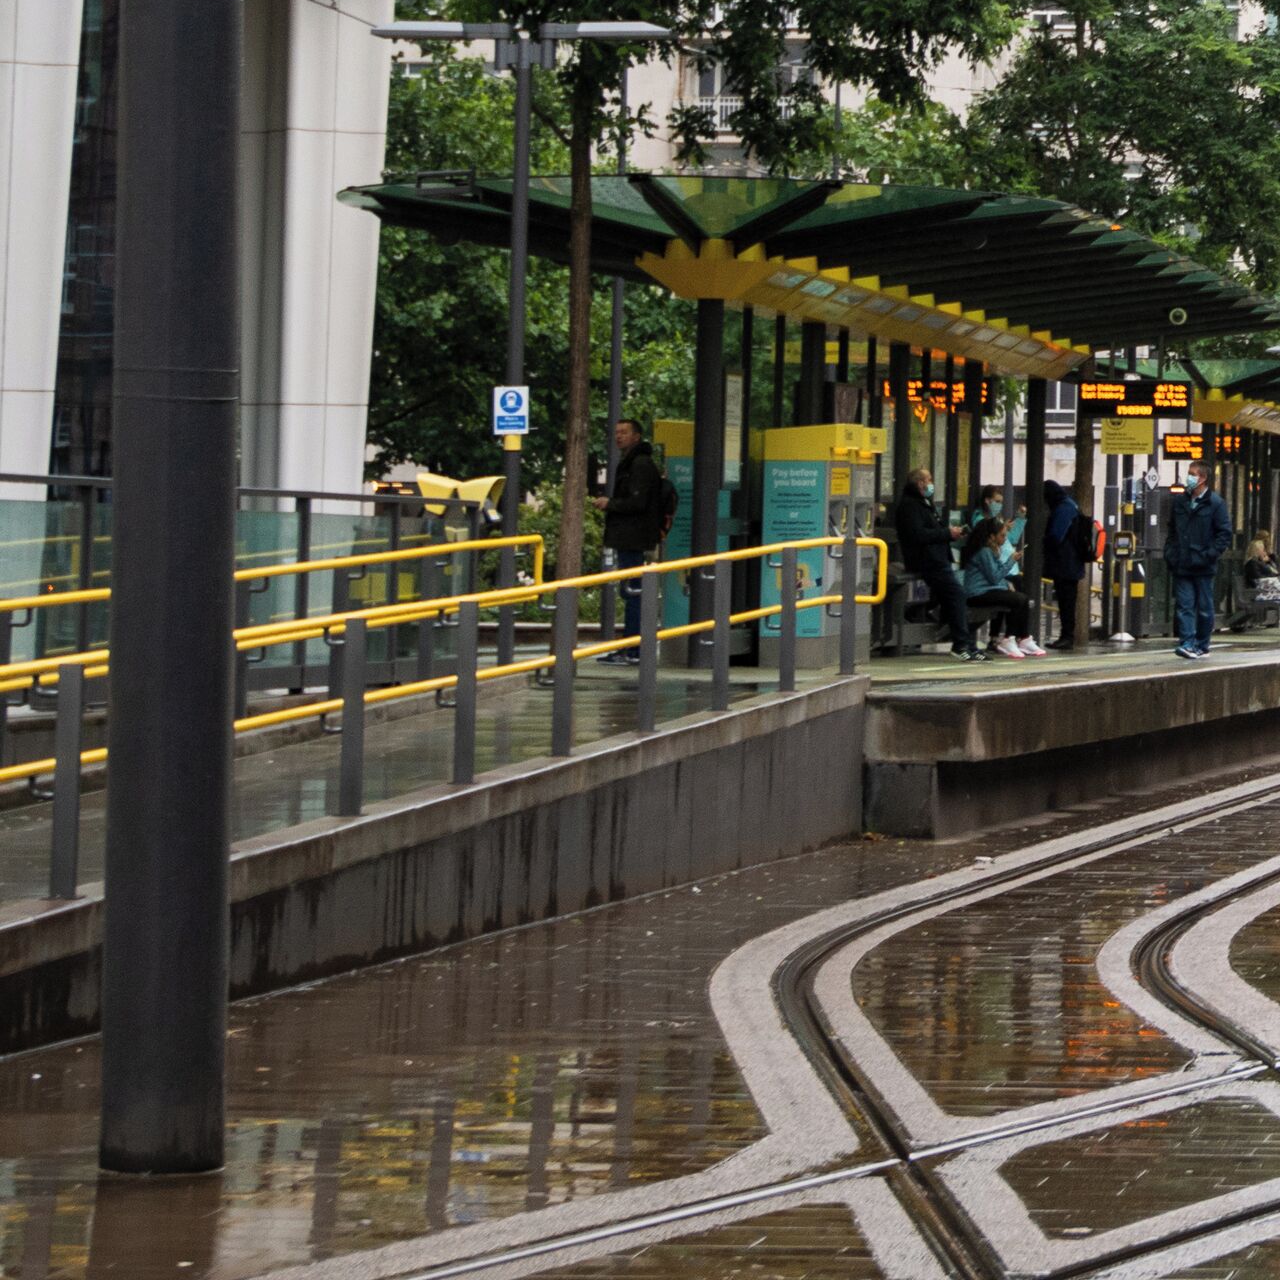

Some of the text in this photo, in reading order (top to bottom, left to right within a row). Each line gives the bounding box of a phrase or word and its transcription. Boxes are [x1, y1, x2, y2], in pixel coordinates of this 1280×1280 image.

[772, 468, 819, 478] Pay before
[774, 478, 817, 488] you board
